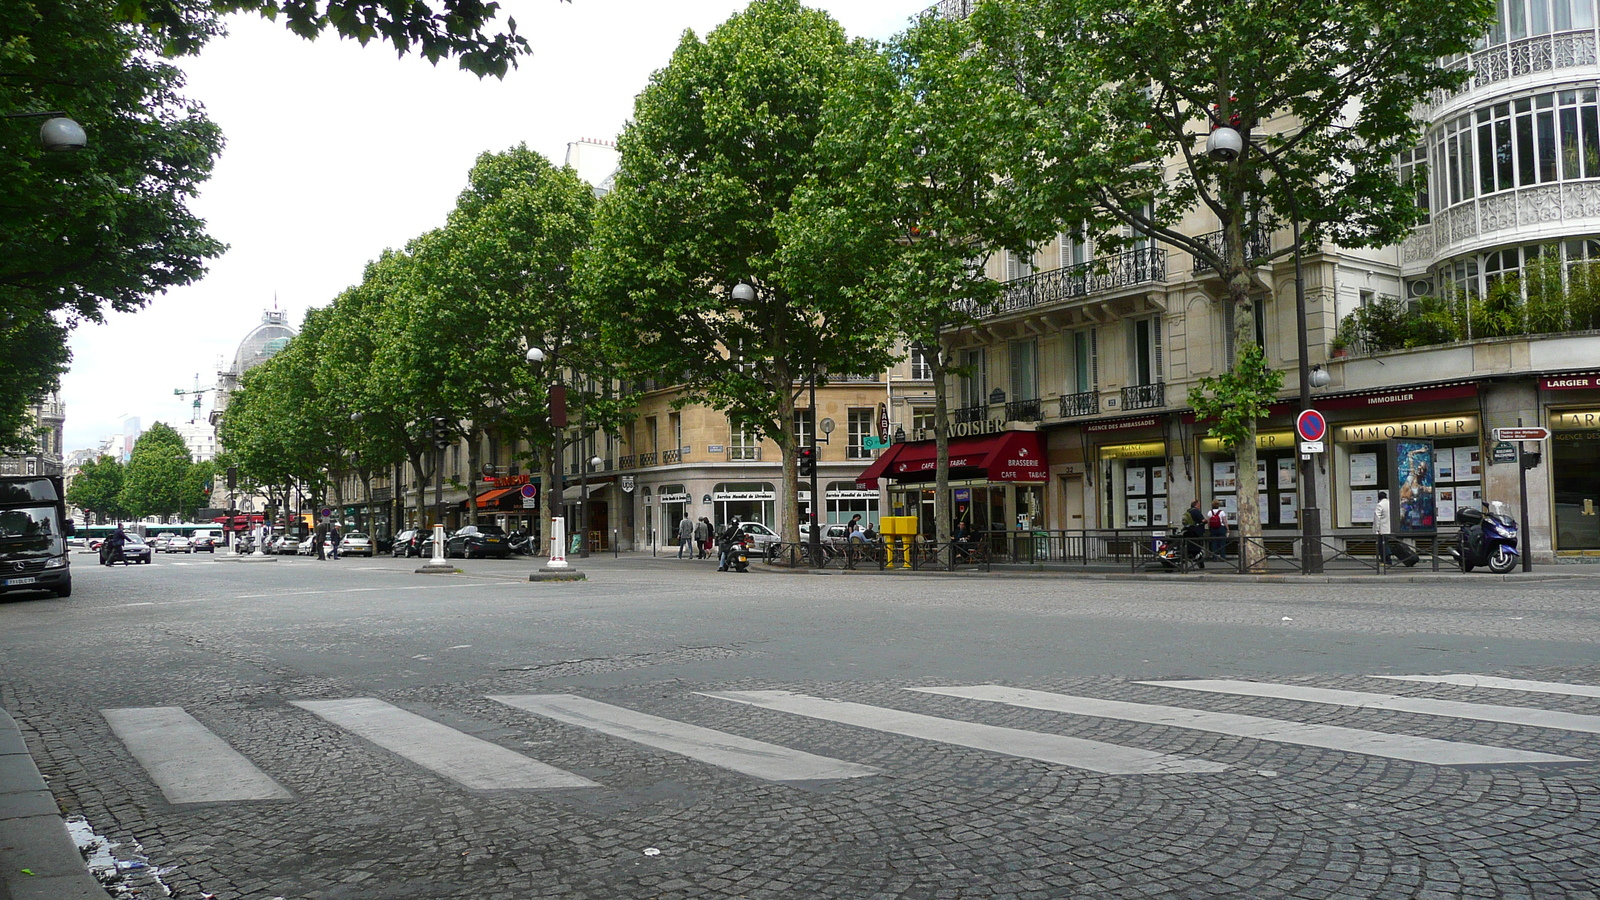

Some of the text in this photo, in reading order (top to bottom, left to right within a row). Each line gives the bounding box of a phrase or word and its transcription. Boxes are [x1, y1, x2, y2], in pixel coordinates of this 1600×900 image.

[1547, 379, 1589, 387] LARGIER
[1368, 393, 1414, 405] IMMOBILIER
[1120, 420, 1155, 428] AMBASSADES
[1560, 413, 1600, 427] LAR
[946, 420, 1004, 438] VOISIER
[1345, 420, 1465, 441] IMMOBILIER
[1556, 433, 1583, 441] AGENCE
[622, 481, 634, 490] ups
[1156, 540, 1162, 552] P
